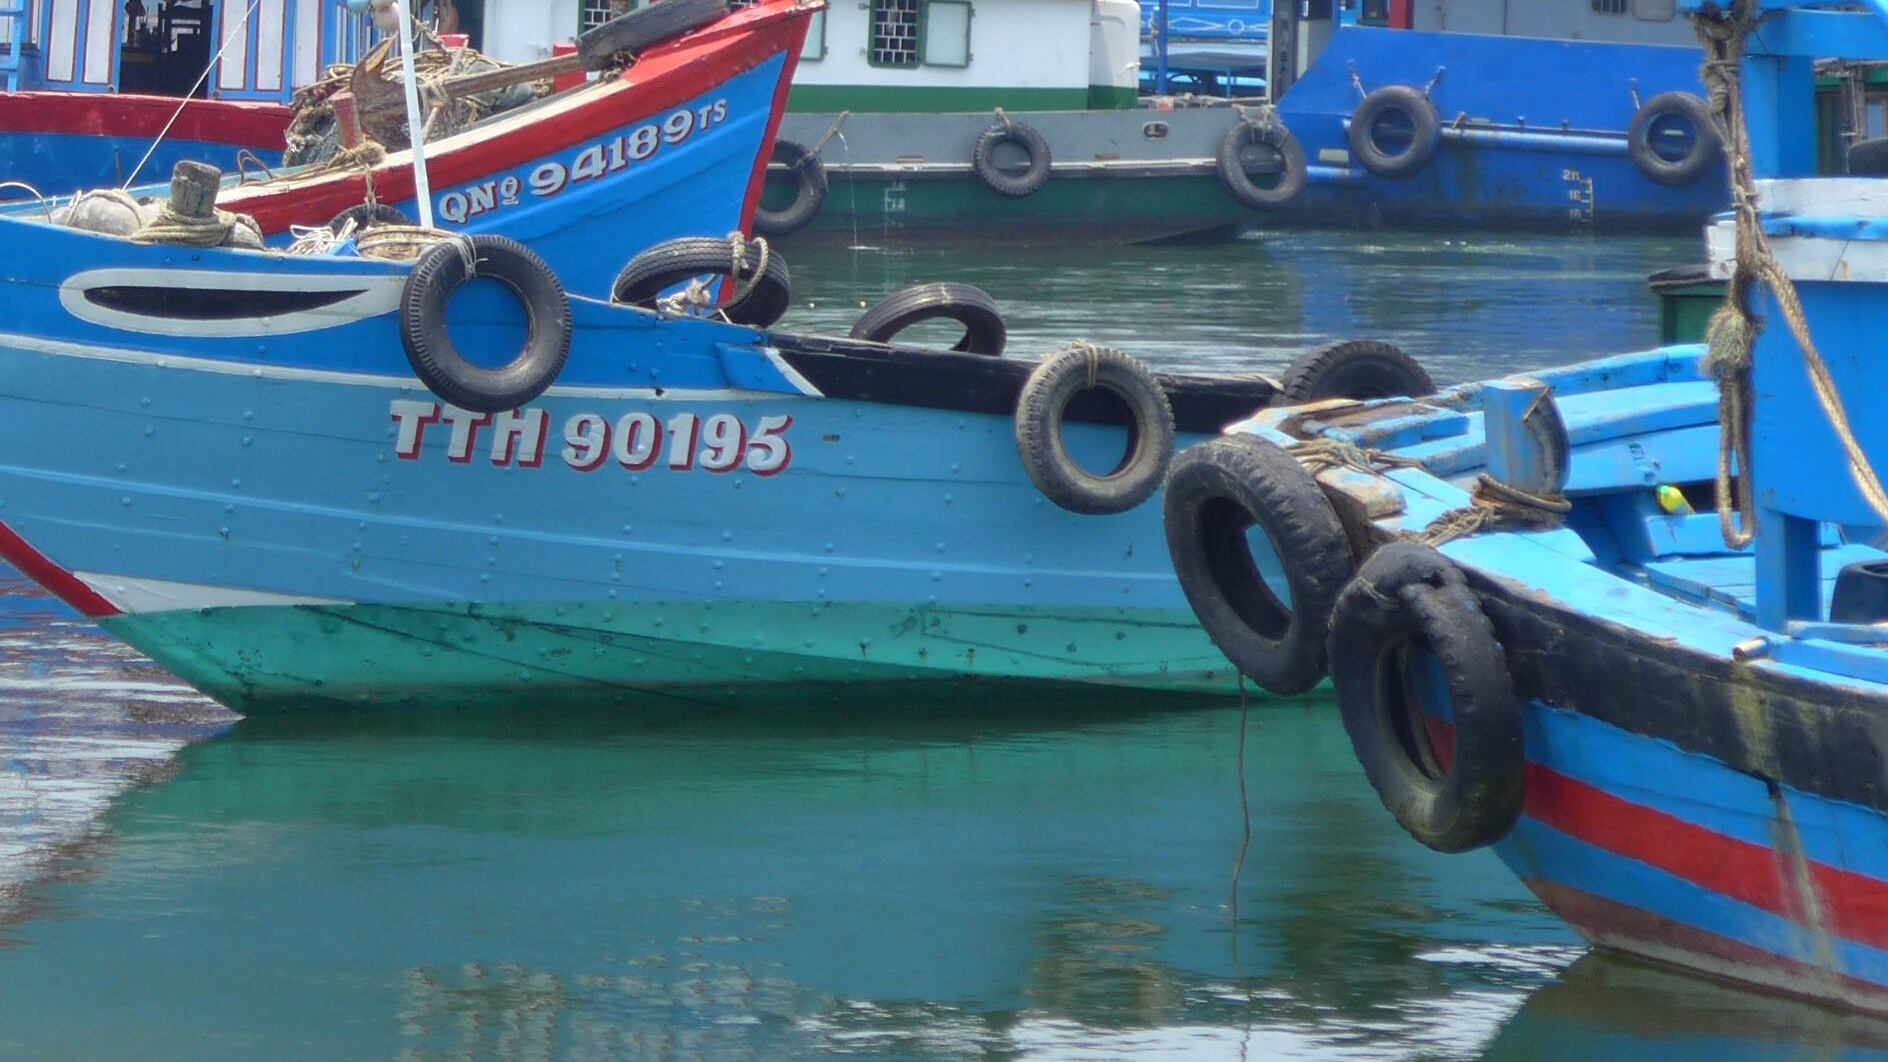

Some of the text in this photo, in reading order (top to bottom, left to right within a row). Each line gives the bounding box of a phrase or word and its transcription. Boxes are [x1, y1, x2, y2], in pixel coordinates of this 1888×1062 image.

[528, 108, 695, 196] 94189
[698, 98, 728, 132] TS
[390, 398, 794, 478] TTH 90195
